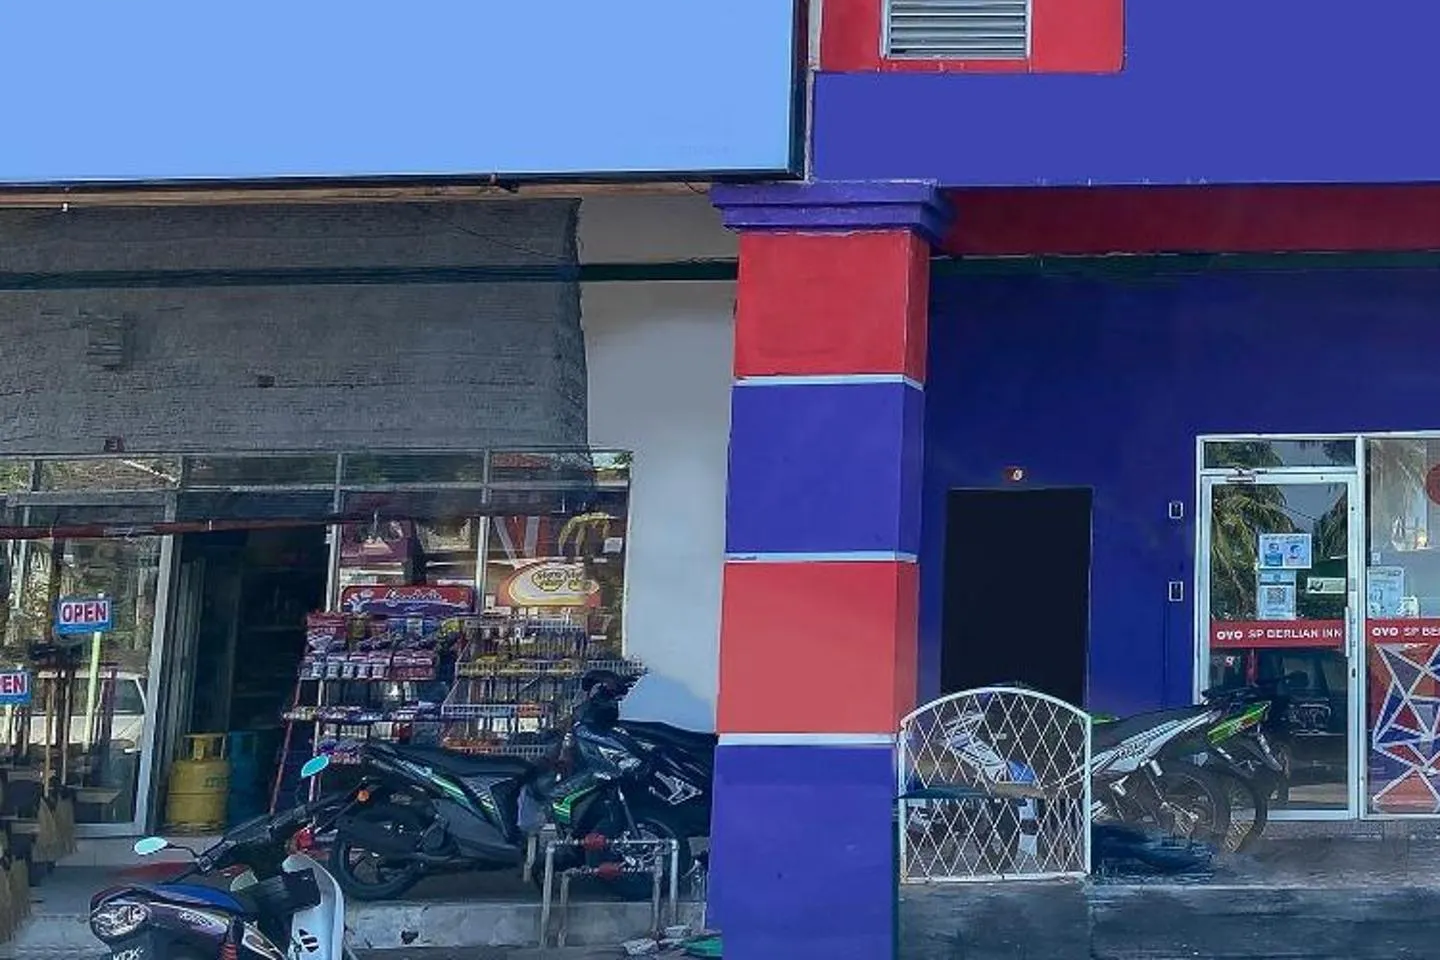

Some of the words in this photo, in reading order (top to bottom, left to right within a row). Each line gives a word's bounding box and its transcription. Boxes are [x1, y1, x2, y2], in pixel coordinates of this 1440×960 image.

[62, 603, 106, 622] OPEN
[1217, 631, 1243, 640] OYO
[1267, 629, 1318, 639] BERLIAN
[1372, 627, 1398, 636] OYO
[2, 675, 25, 693] EN
